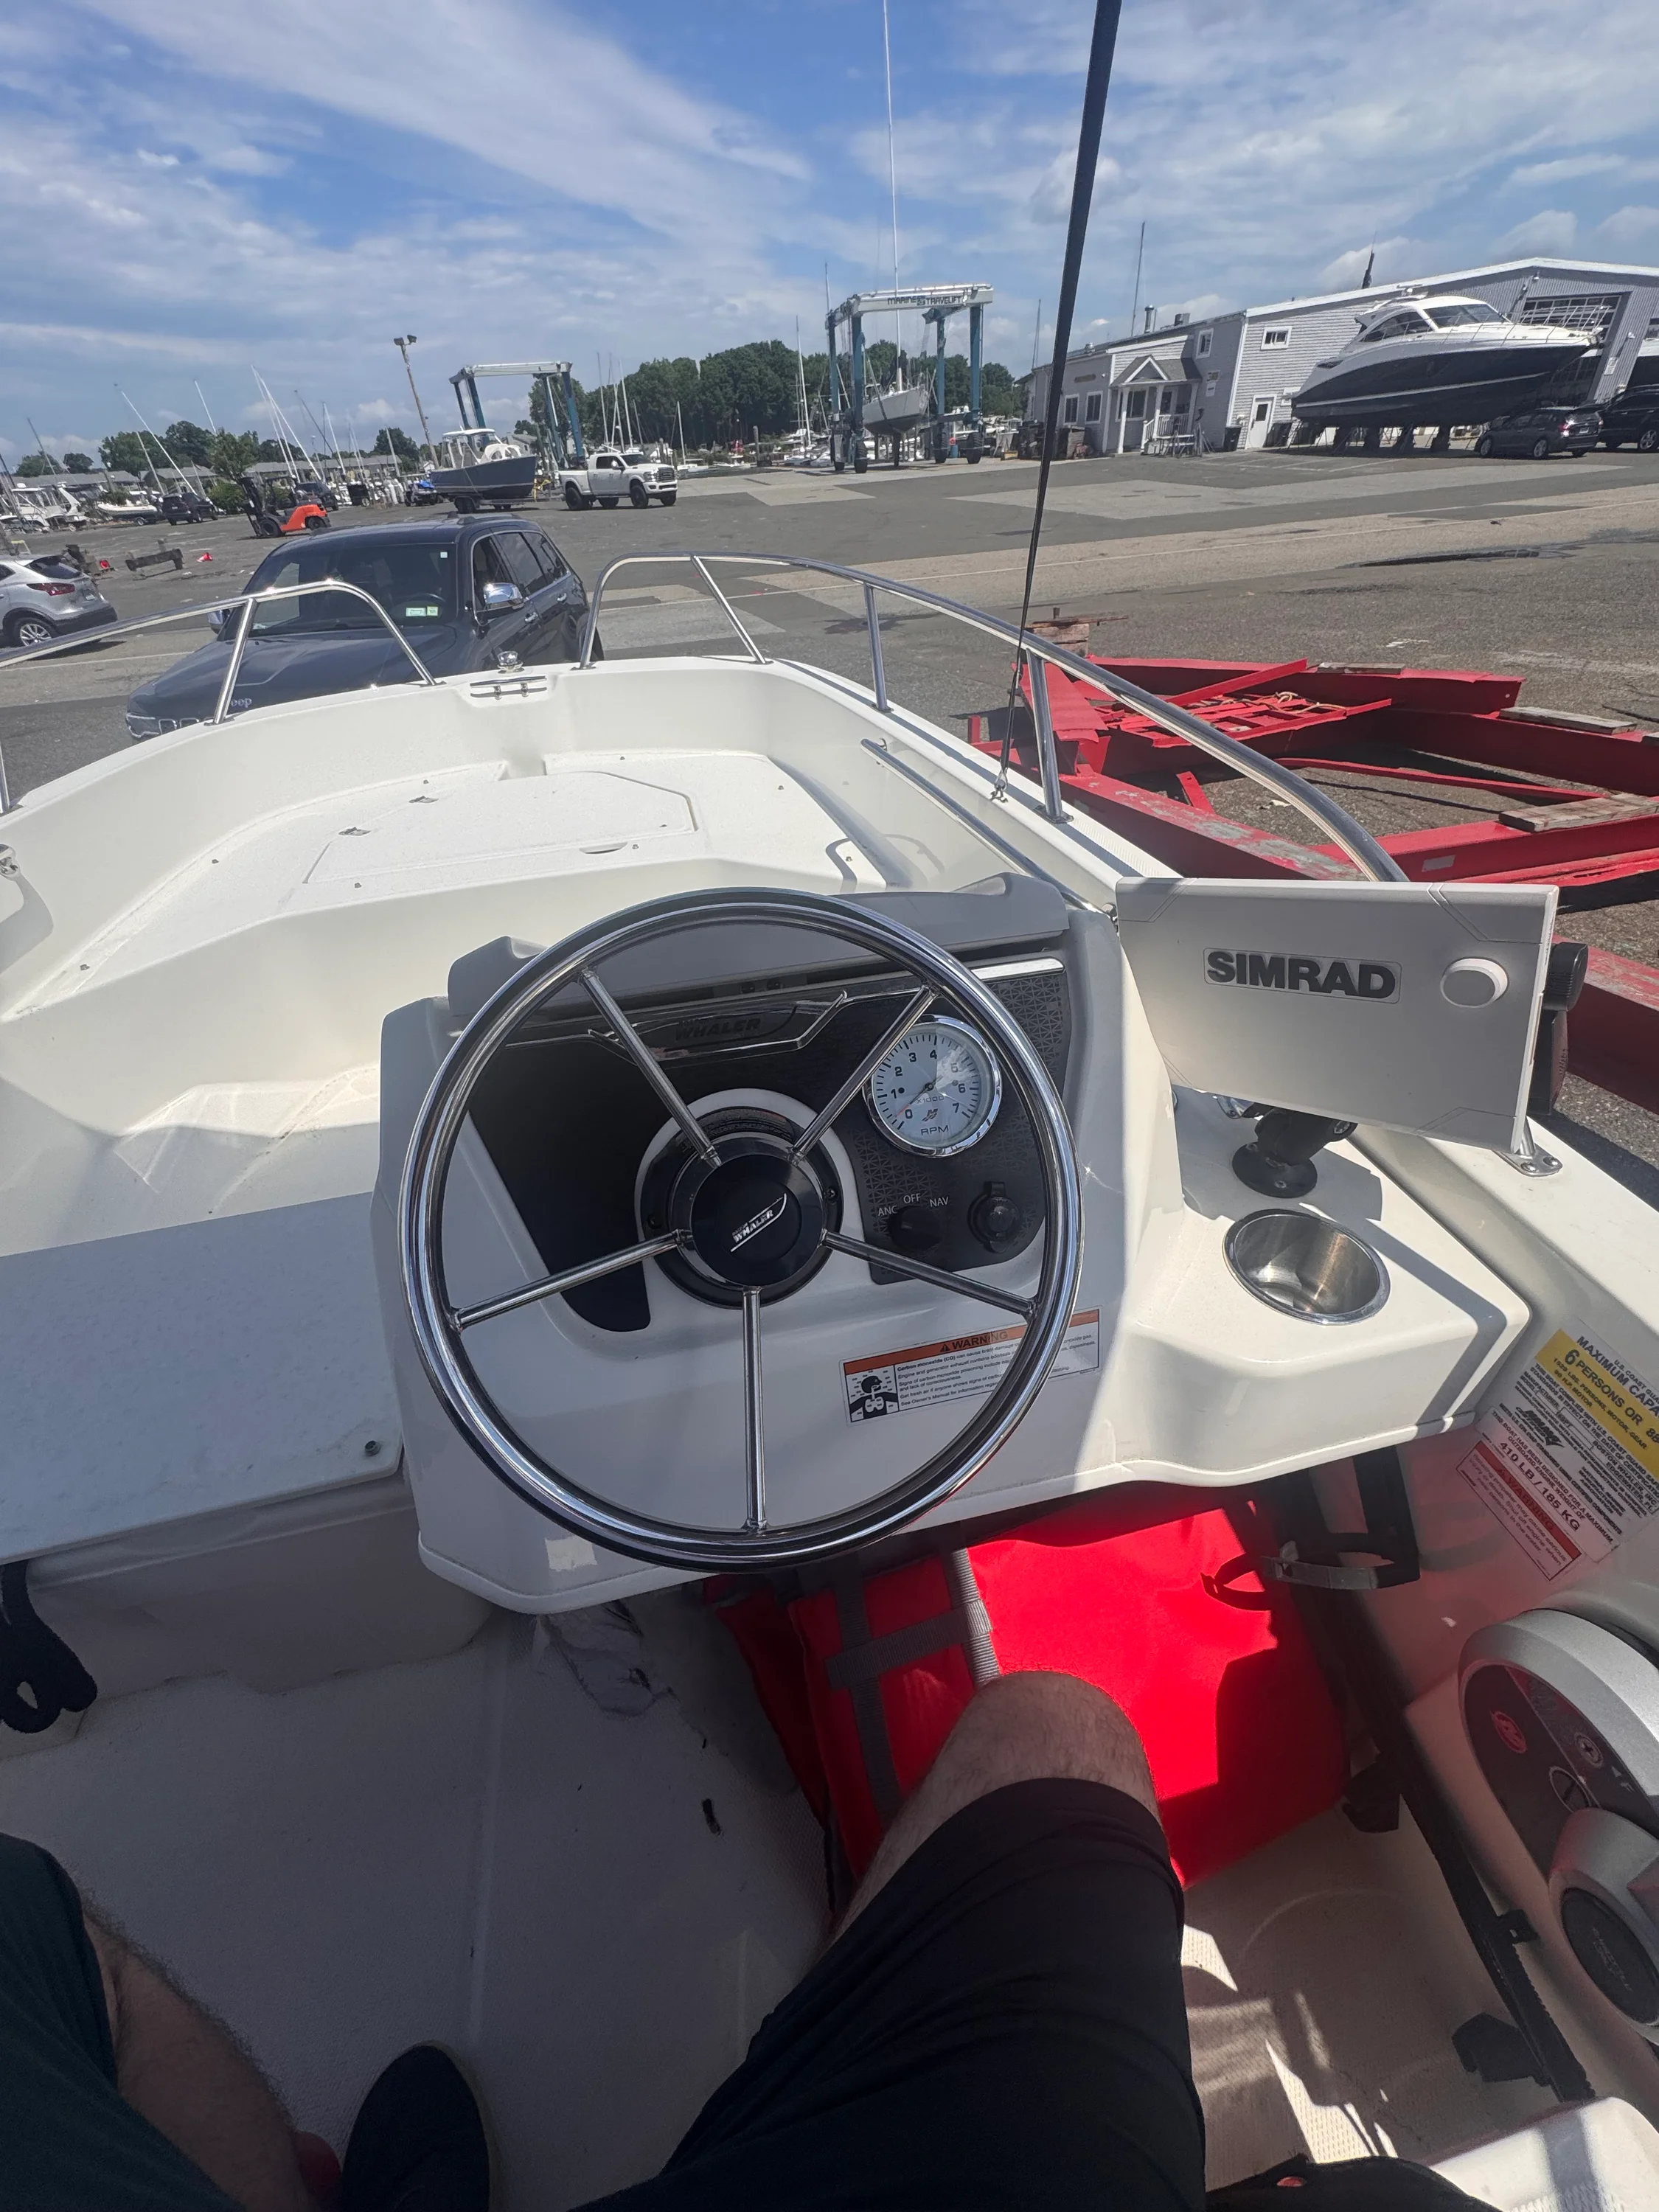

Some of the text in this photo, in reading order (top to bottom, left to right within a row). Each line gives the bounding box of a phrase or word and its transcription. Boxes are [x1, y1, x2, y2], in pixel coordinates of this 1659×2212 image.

[888, 296, 961, 305] MARINE TRAVELIFT
[231, 698, 252, 708] eep
[1207, 951, 1396, 999] SIMRAD
[908, 1052, 917, 1062] 3
[930, 1049, 937, 1060] 4
[950, 1062, 959, 1073] 5
[894, 1066, 902, 1077] 2
[891, 1089, 897, 1099] 1
[959, 1084, 966, 1093] 6
[905, 1109, 913, 1119] 0
[953, 1102, 960, 1113] 7
[920, 1124, 949, 1135] RPM
[877, 1205, 897, 1217] ANC
[903, 1193, 921, 1204] OFF
[929, 1196, 949, 1208] NAV
[733, 1210, 774, 1243] WHALER
[952, 1332, 1008, 1350] WARNING
[1565, 1349, 1580, 1365] 6
[1575, 1360, 1625, 1408] PERSONS
[1624, 1407, 1643, 1426] OR
[1576, 1336, 1659, 1416] MAXIMUM CAPA
[1614, 1360, 1646, 1389] U.S. COAST
[1530, 1366, 1560, 1396] STANDARDS
[1563, 1399, 1583, 1419] EFFECT
[1582, 1419, 1591, 1428] ON
[1590, 1427, 1602, 1439] THE
[1601, 1438, 1616, 1453] DATE
[1615, 1452, 1624, 1460] OF
[1567, 1371, 1647, 1450] LBS. PERSONS, MOTOR, GEAR
[1571, 1387, 1593, 1408] MOTOR
[1515, 1407, 1547, 1438] CERTIFIED
[1530, 1397, 1559, 1425] COMPLIANCE
[1558, 1424, 1571, 1436] WITH
[1534, 1363, 1546, 1375] THIS
[1545, 1374, 1560, 1388] BOAT
[1557, 1387, 1585, 1413] COMPLIES
[1583, 1411, 1598, 1426] WITH
[1596, 1425, 1607, 1436] U.S.
[1607, 1436, 1627, 1454] COAST
[1625, 1454, 1646, 1475] GUARD
[1492, 1411, 1503, 1424] THIS
[1502, 1422, 1517, 1438] BOAT
[1516, 1437, 1528, 1450] HAS
[1526, 1449, 1543, 1466] BEEN
[1541, 1464, 1568, 1494] DESIGNED
[1568, 1494, 1581, 1508] FOR
[1499, 1403, 1512, 1417] MEETS
[1518, 1424, 1527, 1433] EPA
[1536, 1442, 1560, 1468] STANDARDS
[1592, 1502, 1622, 1534] COMPONENTS
[1577, 1450, 1588, 1461] FOR
[1591, 1440, 1618, 1466] BOSTON
[1615, 1464, 1646, 1495] WHALER,
[1499, 1442, 1519, 1463] 410
[1517, 1461, 1535, 1481] LB
[1540, 1487, 1562, 1510] 185
[1559, 1509, 1580, 1531] KG
[1507, 1436, 1536, 1467] OUTBOARD
[1534, 1466, 1555, 1488] ENGINE
[1554, 1487, 1577, 1512] WEIGHT
[1575, 1511, 1585, 1520] OF
[1578, 1470, 1624, 1517] MANUFACTURERS
[1582, 1467, 1604, 1491] NATIONAL
[1604, 1461, 1647, 1503] EDGEWATER,
[1472, 1453, 1494, 1478] Rotating
[1492, 1477, 1517, 1503] propeller
[1516, 1503, 1528, 1517] may
[1528, 1518, 1545, 1537] cause
[1545, 1537, 1567, 1562] serious
[1507, 1477, 1554, 1531] WARNING
[1579, 1479, 1614, 1514] ASSOCIATION
[1489, 1492, 1509, 1515] persons
[1515, 1522, 1526, 1534] the
[1518, 1516, 1527, 1525] off
[1526, 1525, 1545, 1547] engine
[1545, 1548, 1561, 1565] when
